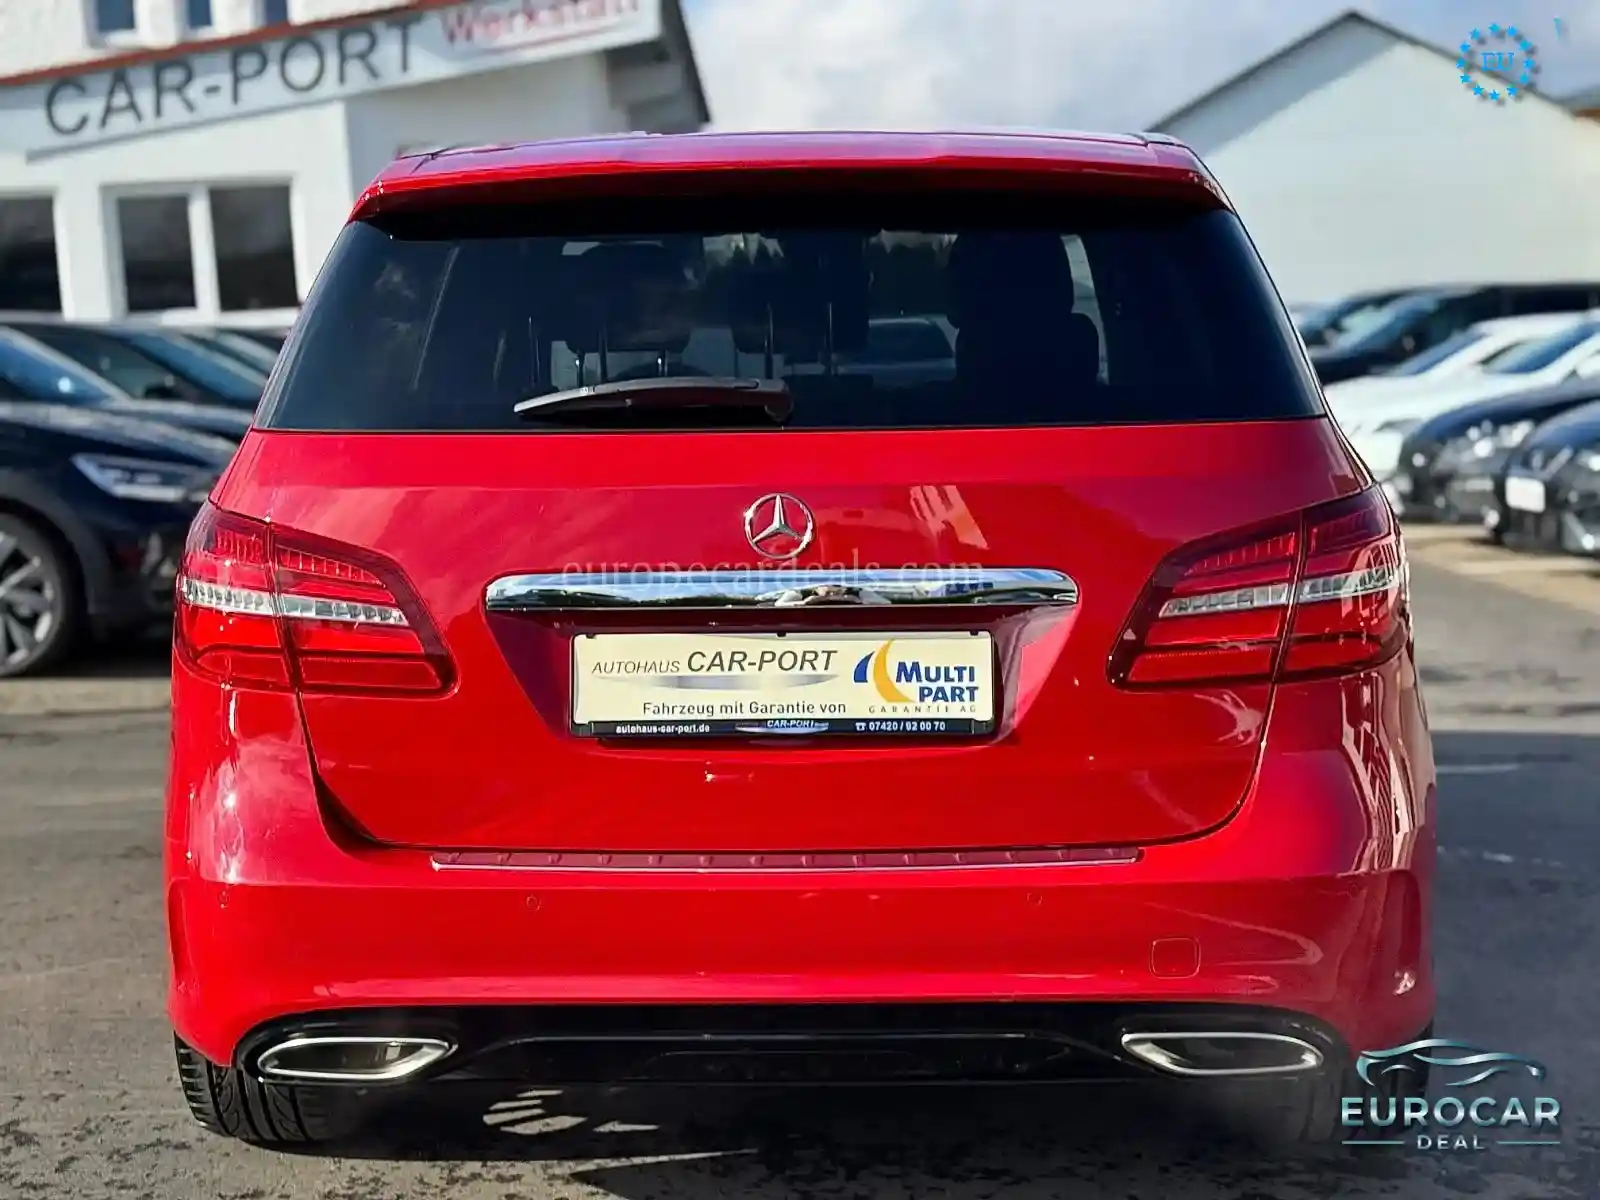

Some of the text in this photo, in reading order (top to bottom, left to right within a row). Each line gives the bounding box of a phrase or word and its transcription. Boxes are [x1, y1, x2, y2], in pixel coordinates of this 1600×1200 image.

[45, 18, 422, 136] CAR-PORT
[591, 649, 838, 675] AUTOHAUS CAR-PORT
[918, 686, 980, 704] PART
[642, 700, 847, 718] Fahrzeug mit Garantie von
[868, 705, 977, 714] GARANTIE AG
[615, 724, 711, 734] autohaus-car-port.de
[868, 721, 899, 732] 07420
[933, 721, 947, 732] 70
